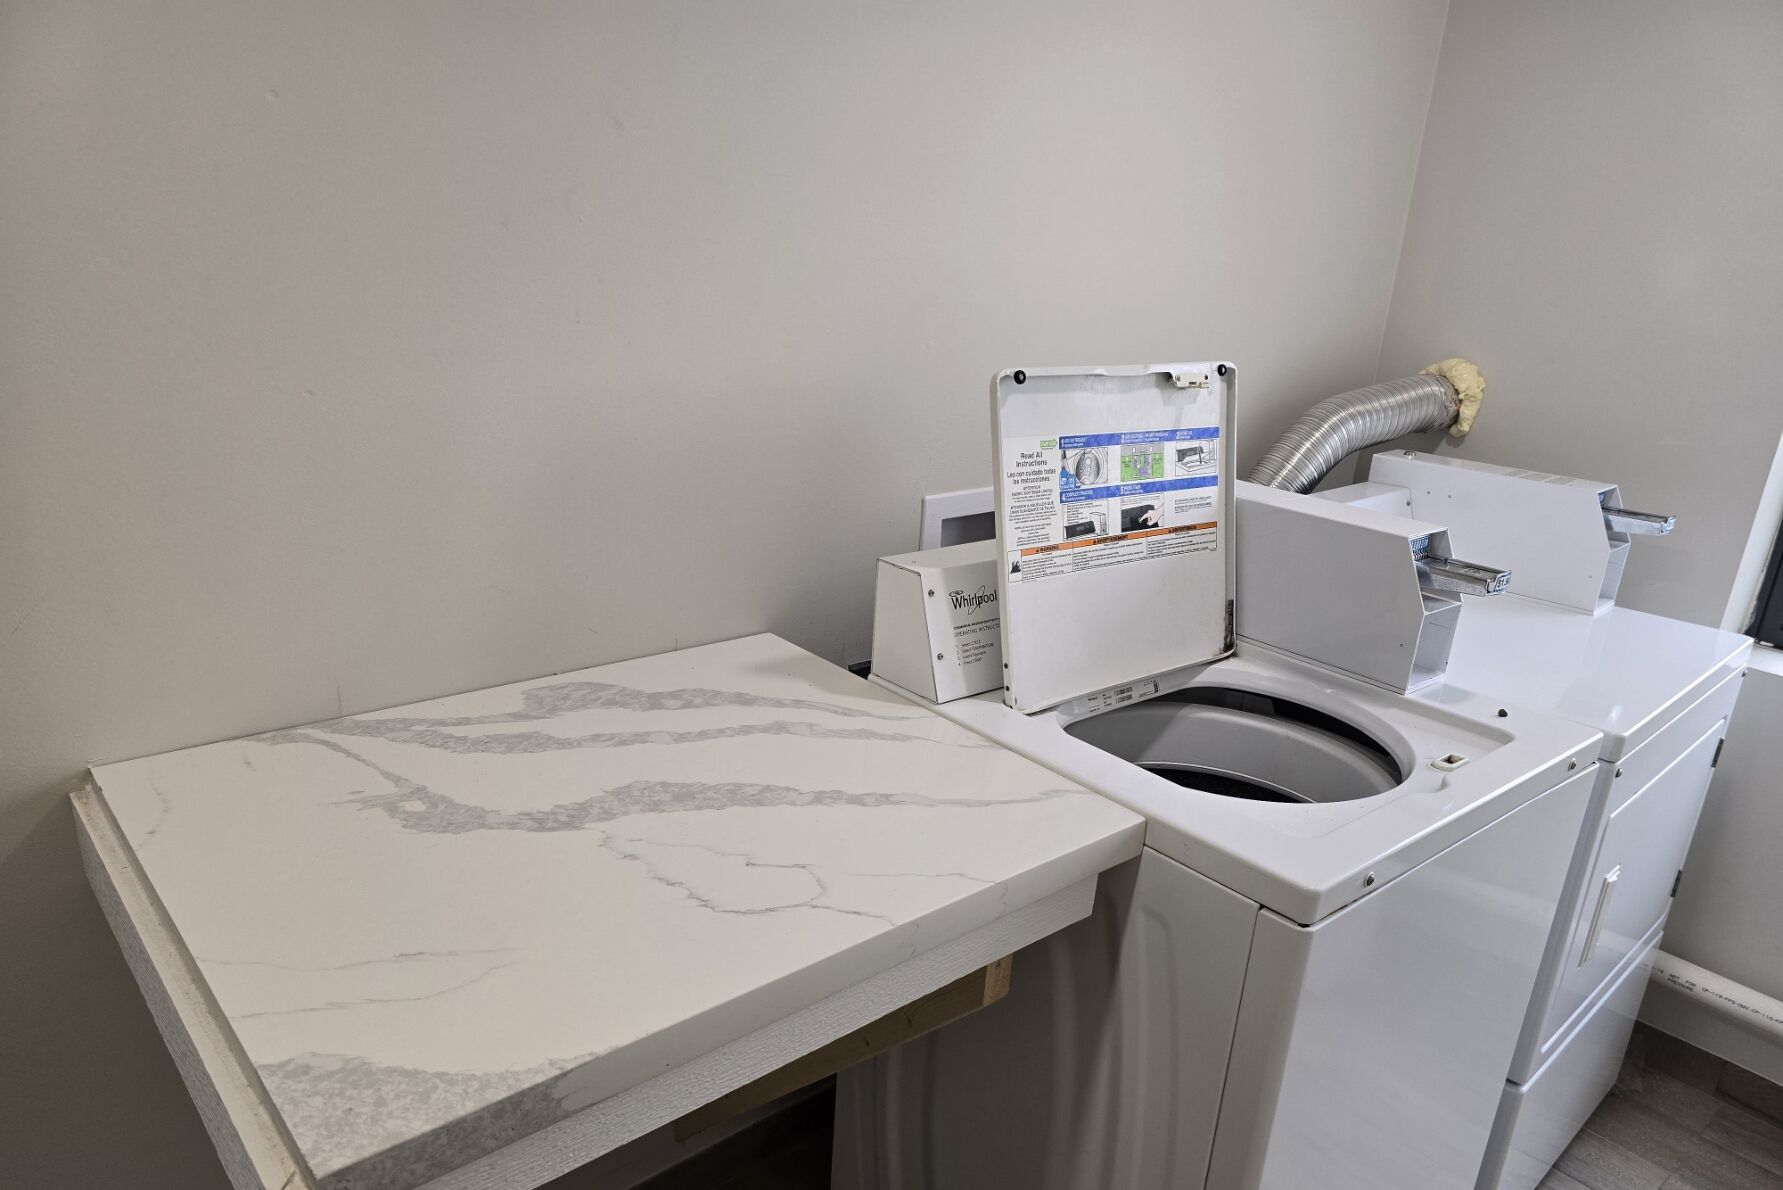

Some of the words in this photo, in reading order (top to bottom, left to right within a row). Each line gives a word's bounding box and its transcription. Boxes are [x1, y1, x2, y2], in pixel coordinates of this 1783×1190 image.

[1016, 459, 1047, 468] Instructions
[951, 589, 998, 610] Whirlpool
[979, 622, 1001, 633] INSTRUCTIO
[1667, 977, 1695, 993] PRESSURE
[1669, 973, 1680, 981] NOT
[1685, 979, 1697, 988] FOR
